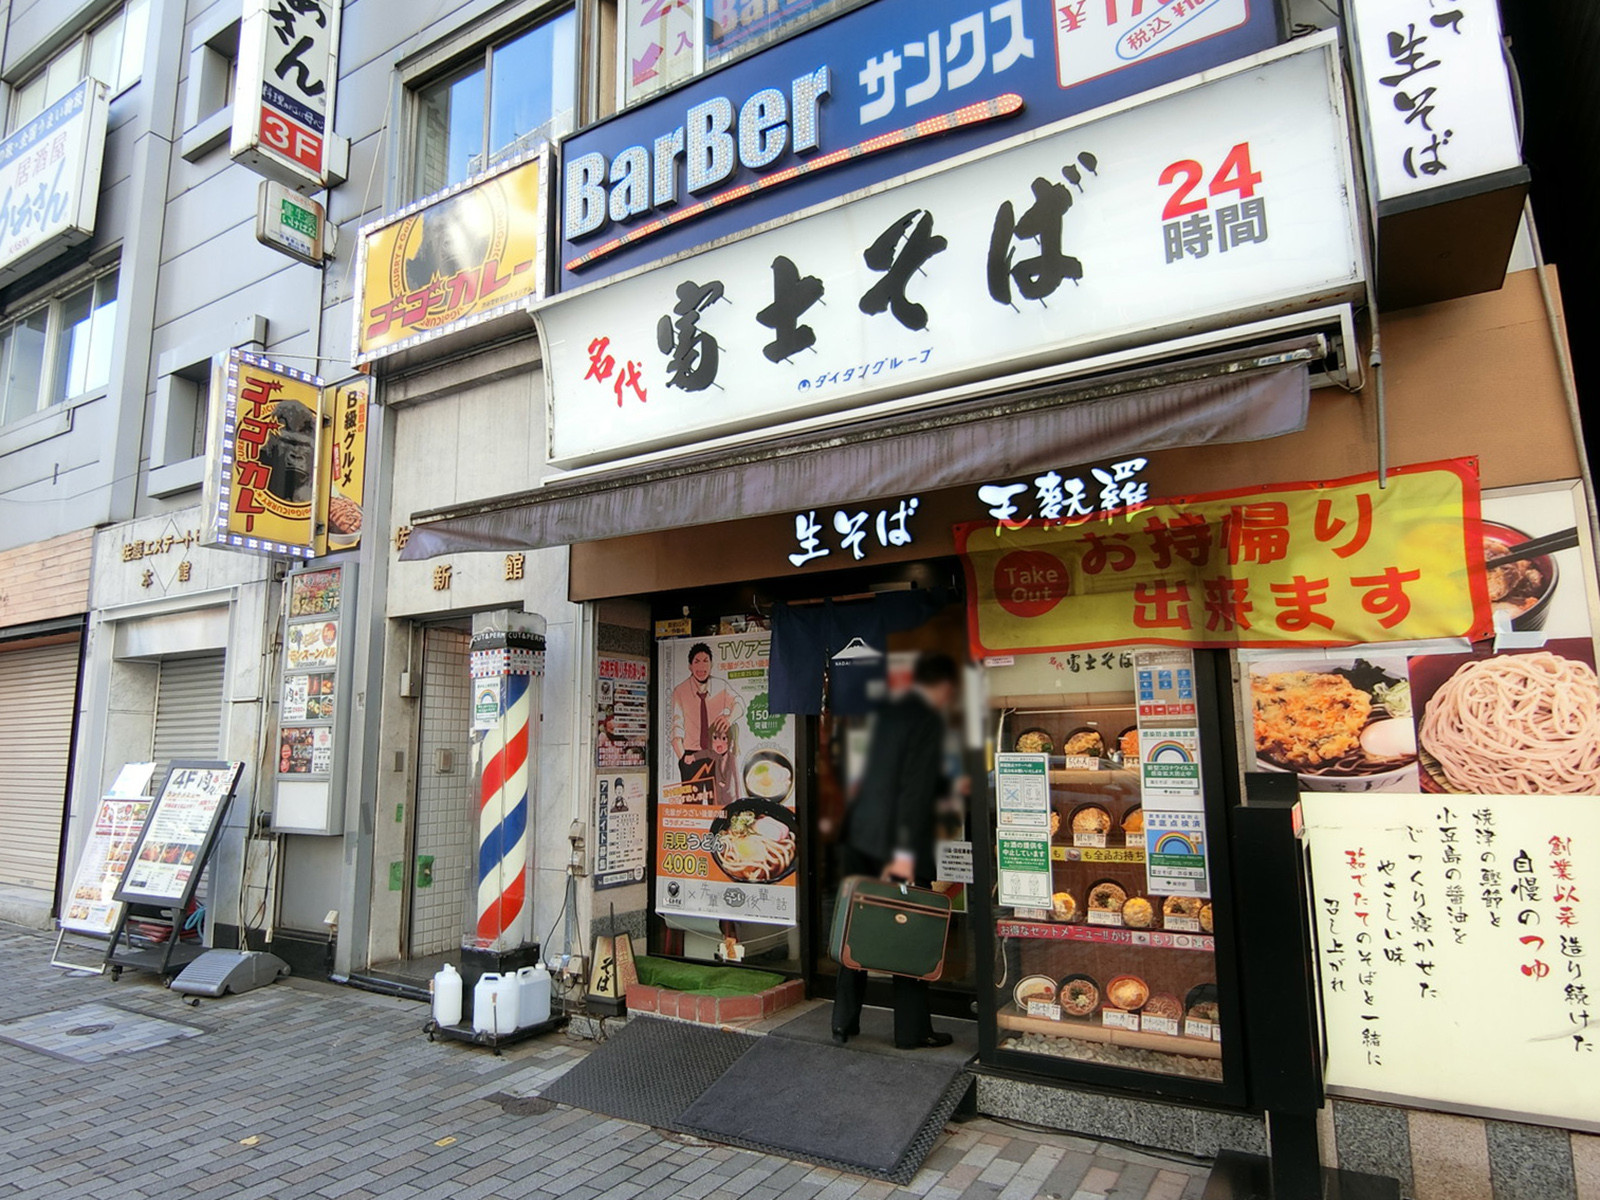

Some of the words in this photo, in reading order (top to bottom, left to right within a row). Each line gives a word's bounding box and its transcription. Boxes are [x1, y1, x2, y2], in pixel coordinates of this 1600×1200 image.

[859, 0, 1034, 125] サンクス
[1126, 15, 1172, 51] 税込
[1379, 23, 1453, 178] 生そば
[265, 116, 319, 158] 3F
[564, 64, 833, 241] BarBer
[1158, 142, 1262, 221] 24
[1162, 196, 1268, 264] 時間
[366, 259, 533, 341] ゴーゴーカレー
[657, 151, 1098, 392] 富士そば
[584, 337, 648, 408] 名代
[815, 347, 934, 388] ダイタングループ
[235, 376, 284, 533] ゴーゴーカレー
[341, 390, 358, 488] B級グルメ
[788, 497, 919, 568] 生そば
[1081, 492, 1375, 576] お持帰り
[433, 552, 525, 591] 新館
[1003, 565, 1059, 588] Take
[1010, 587, 1053, 605] Out
[1132, 565, 1422, 635] 出来ます
[474, 631, 506, 642] CUT&PERM
[508, 633, 545, 643] CUT&PERM
[718, 640, 772, 660] TVアニ
[662, 831, 724, 853] 月見うどん
[662, 854, 709, 876] 400円
[1002, 849, 1045, 858] 中止しています
[1323, 898, 1347, 993] 召し上がれ
[1377, 858, 1407, 967] やさしい味
[1406, 826, 1438, 999] じっくり寝かせた
[1510, 849, 1550, 982] 自慢のつゆ
[596, 957, 614, 993] そば
[1344, 847, 1383, 1067] 茹でたてのそばと一緒に
